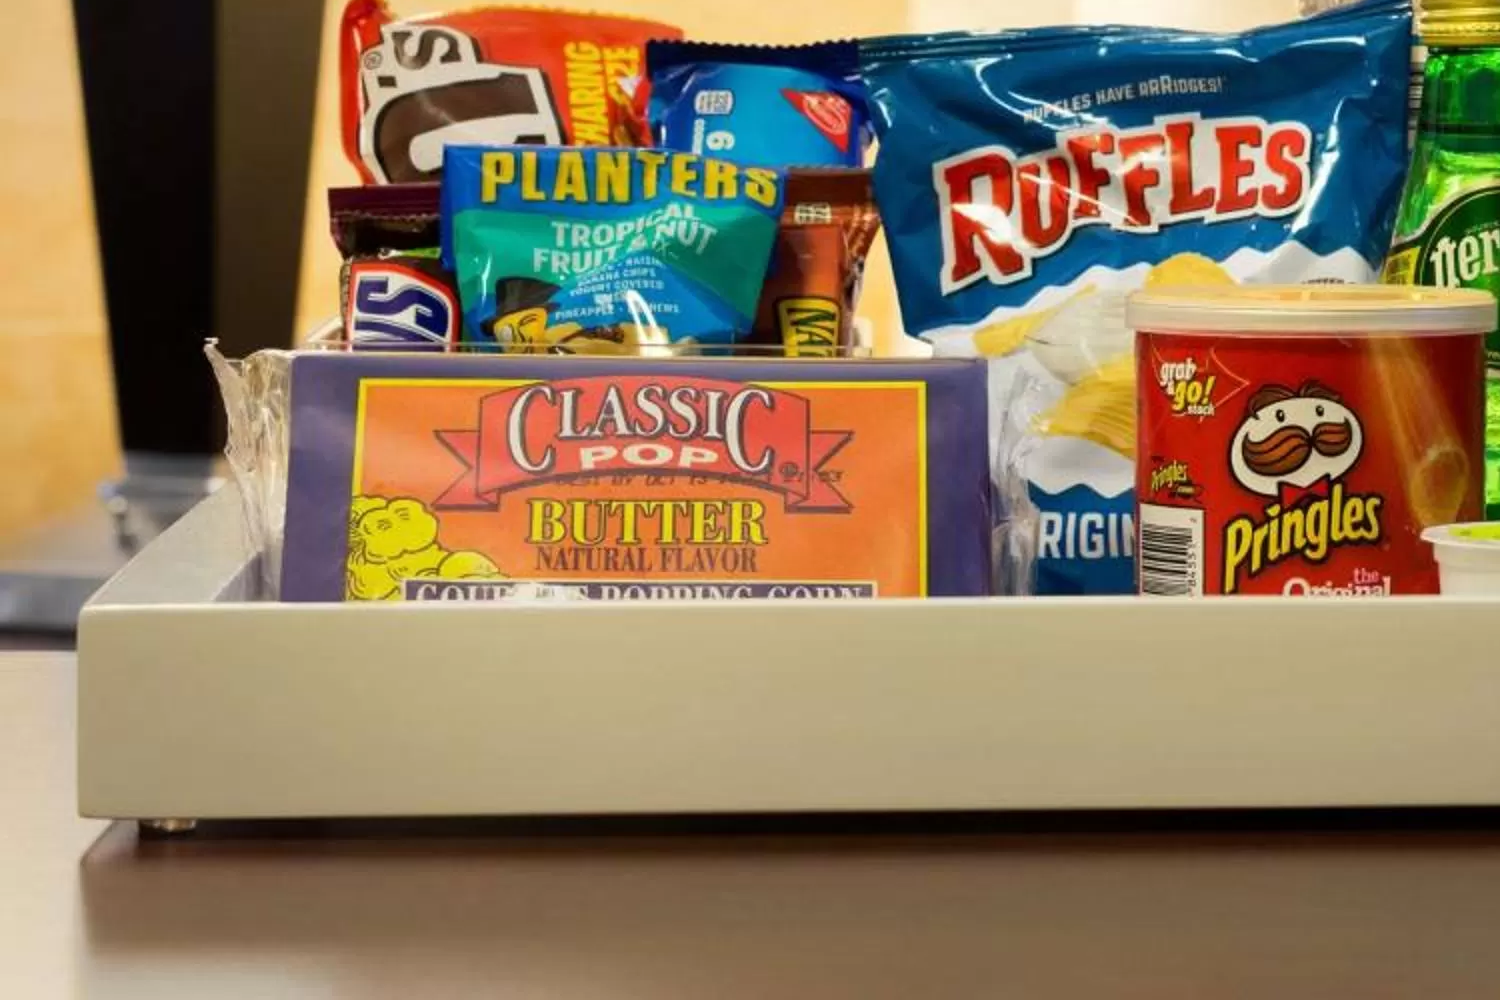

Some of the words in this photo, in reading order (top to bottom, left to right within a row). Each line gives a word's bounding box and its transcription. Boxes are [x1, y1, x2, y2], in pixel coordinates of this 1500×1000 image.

[564, 41, 610, 146] HARING
[1095, 83, 1136, 105] HAVE
[480, 150, 778, 208] PLANTERS
[940, 118, 1309, 286] RUFFLES
[533, 244, 621, 274] FRUIT
[651, 218, 718, 255] NUT
[551, 201, 701, 248] TROPICAL
[1160, 357, 1198, 387] grab
[1172, 375, 1217, 411] go!
[508, 384, 775, 475] CLASSIC
[578, 443, 719, 470] POP
[526, 498, 769, 545] BUTTER
[1038, 511, 1134, 560] RIGIN
[1224, 482, 1381, 595] Pringles
[534, 546, 656, 573] NATURAL
[660, 546, 758, 573] FLAVOR
[1352, 567, 1380, 584] the
